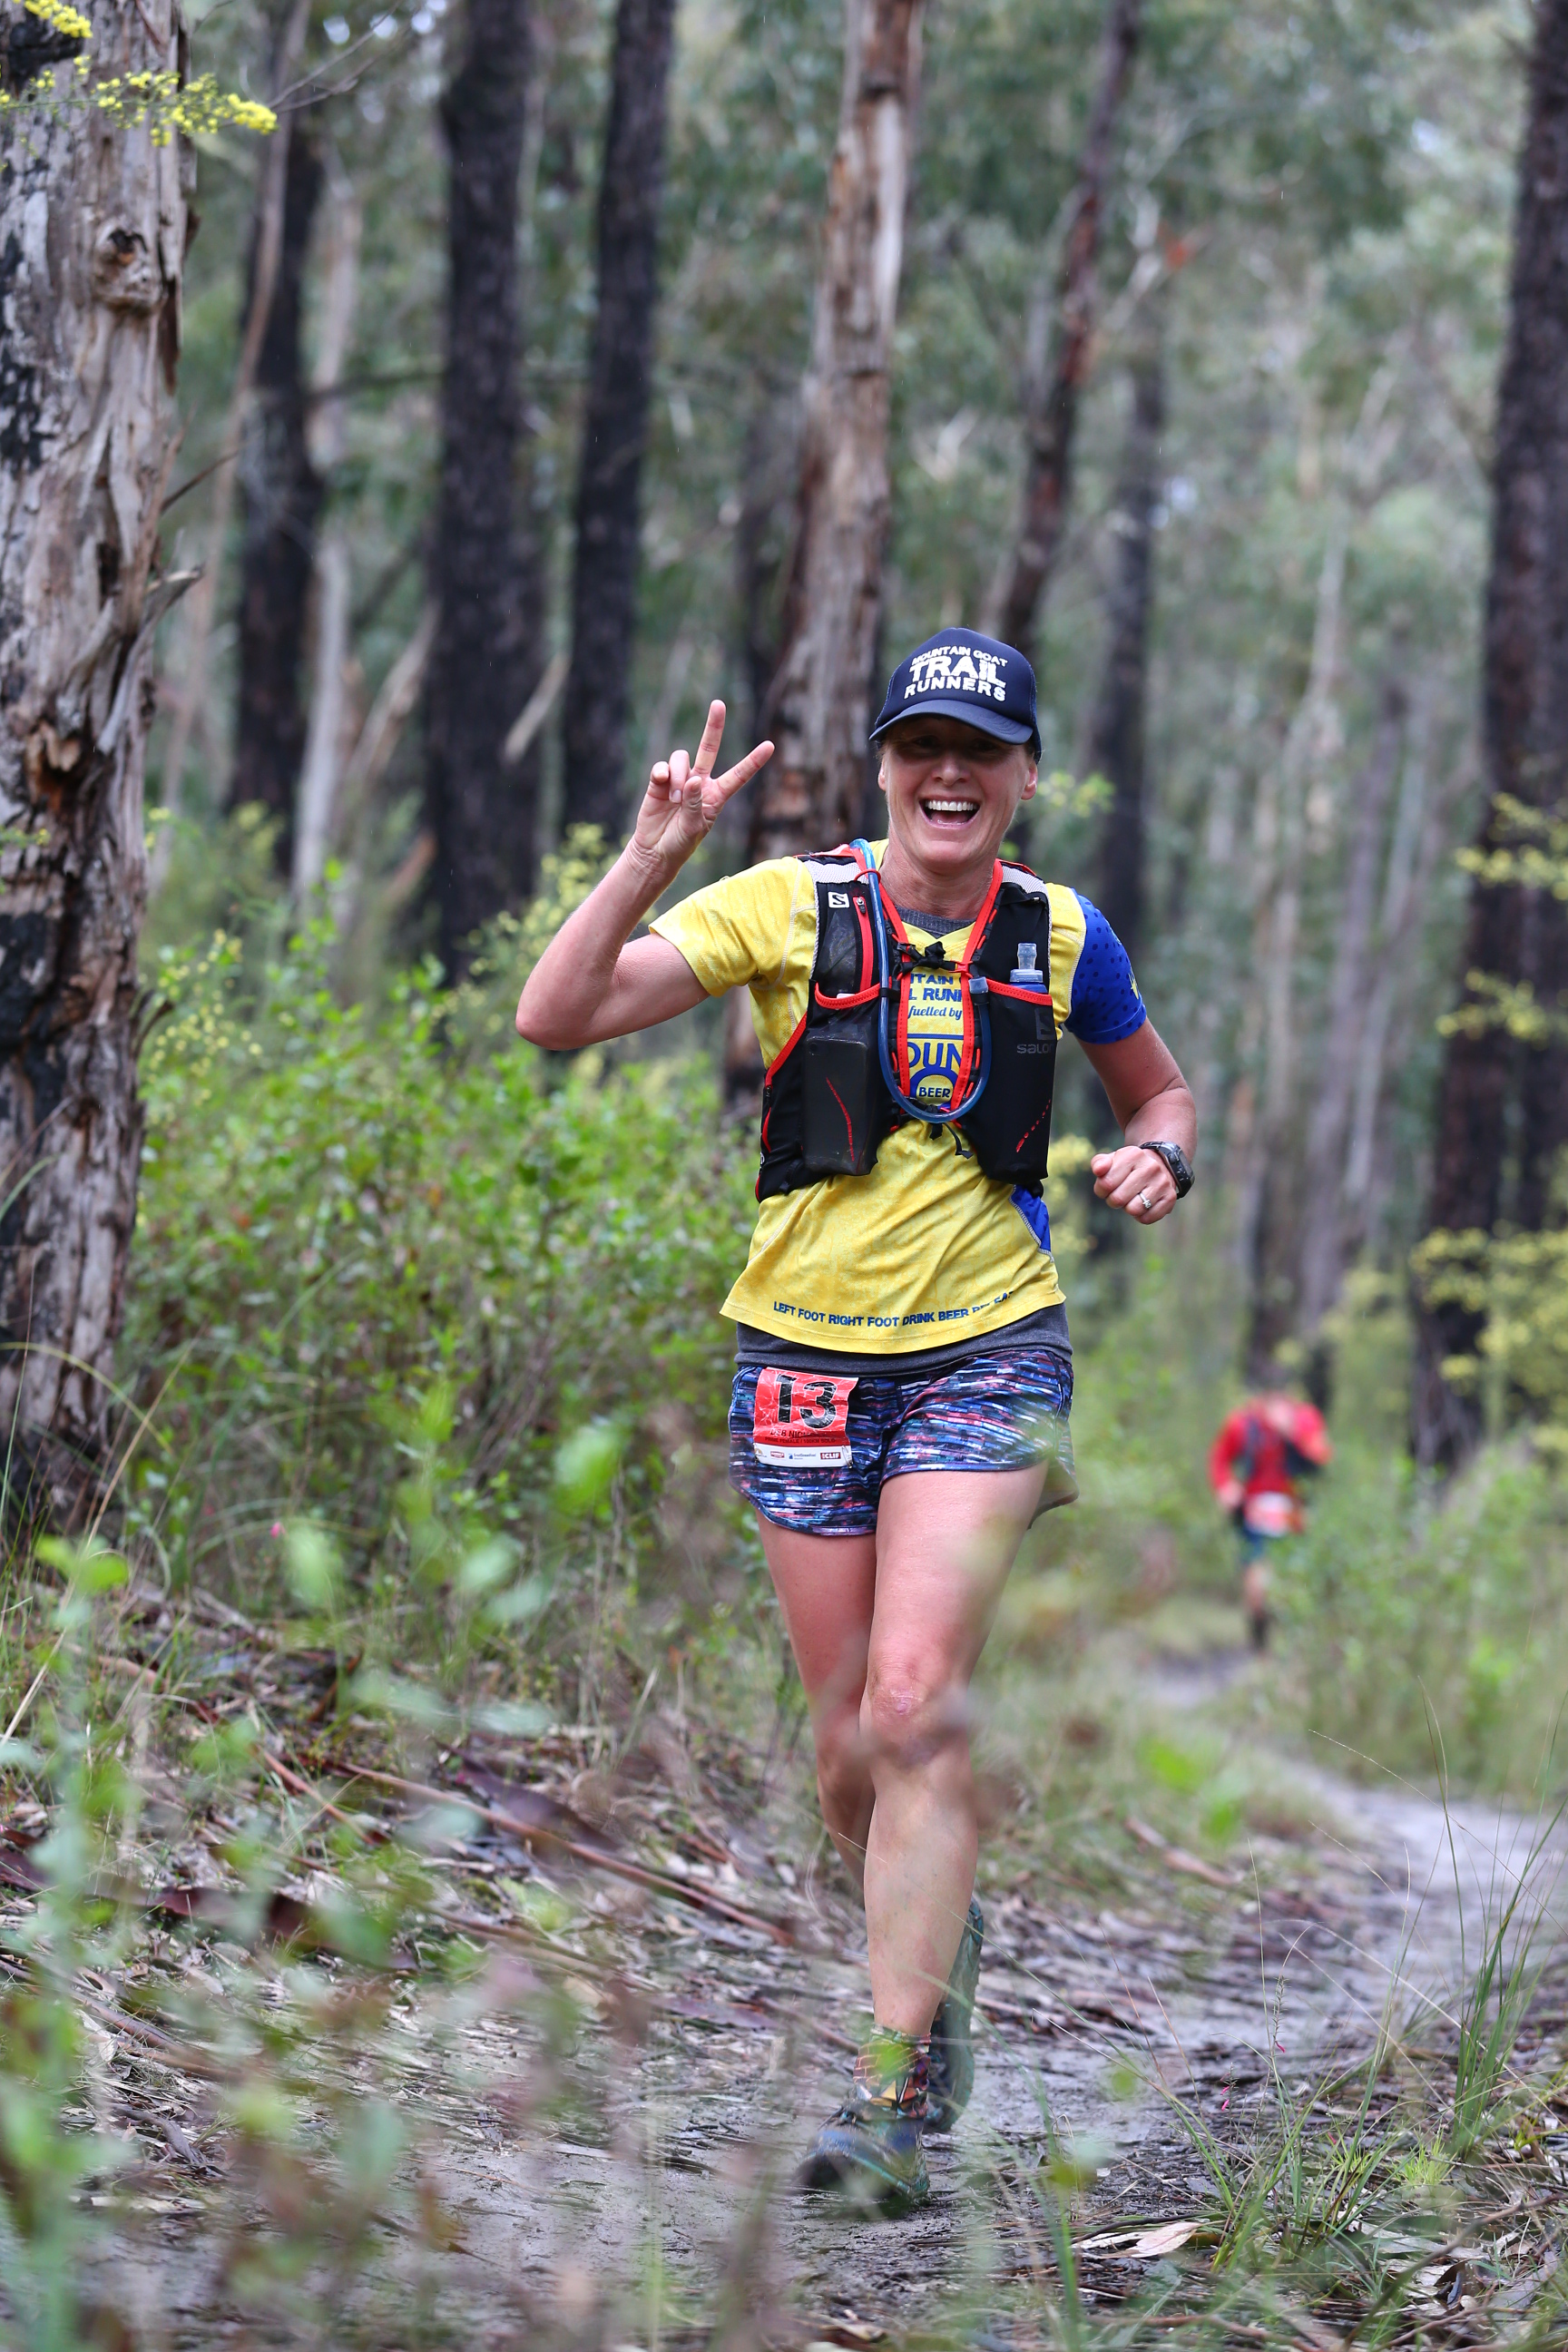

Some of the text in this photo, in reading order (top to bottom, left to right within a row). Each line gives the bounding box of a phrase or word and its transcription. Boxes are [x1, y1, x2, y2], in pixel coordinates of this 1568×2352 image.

[911, 645, 1008, 667] MOUNTAIN GOAT
[908, 655, 1006, 688] TRAIL
[904, 676, 1006, 701] RUNNERS
[907, 1005, 963, 1021] fuelled by
[918, 1086, 951, 1098] BEER
[773, 1301, 796, 1316] LEFT
[798, 1308, 826, 1322] FOOT
[828, 1314, 864, 1326] RIGHT
[867, 1317, 900, 1328] FOOT
[902, 1311, 936, 1326] DRINK
[938, 1308, 969, 1321] BEER
[776, 1374, 838, 1429] 13
